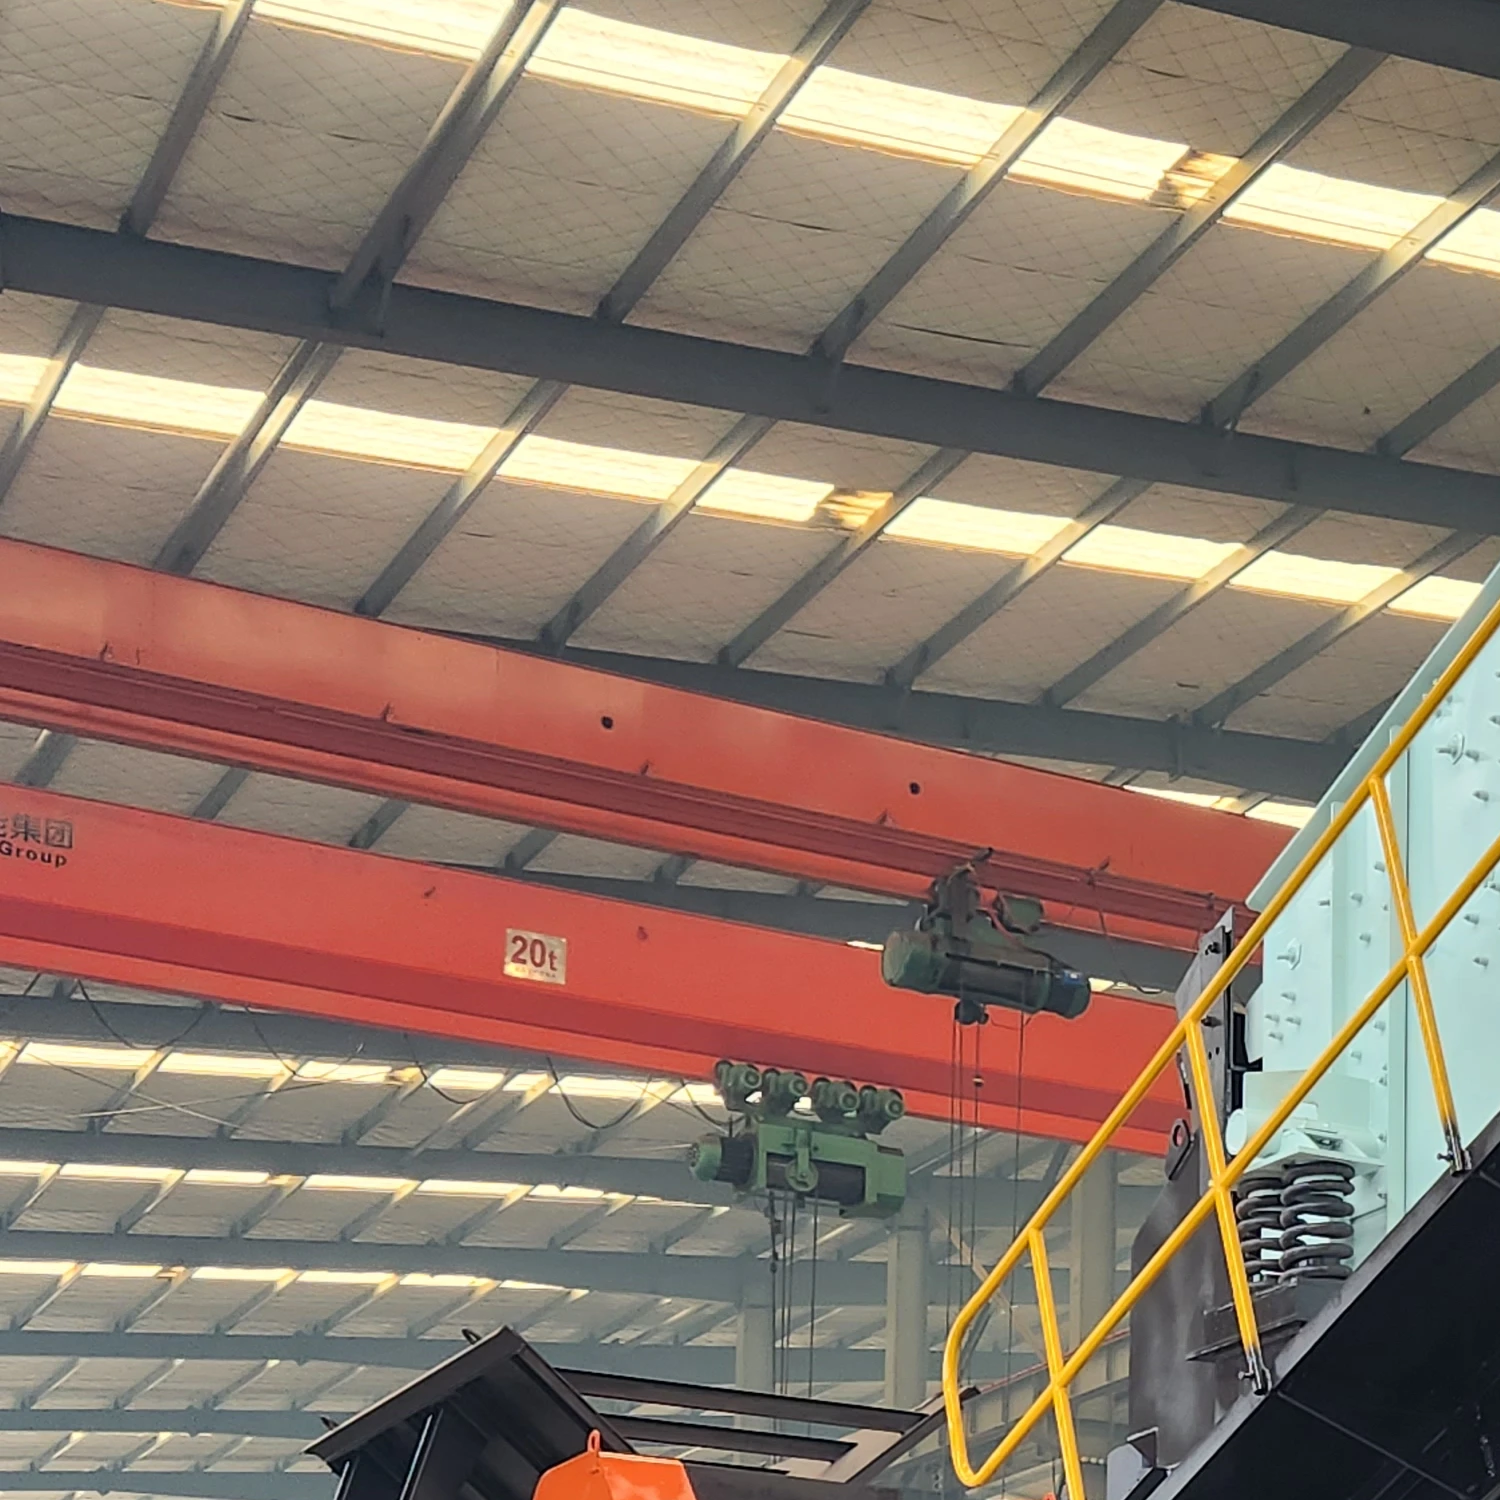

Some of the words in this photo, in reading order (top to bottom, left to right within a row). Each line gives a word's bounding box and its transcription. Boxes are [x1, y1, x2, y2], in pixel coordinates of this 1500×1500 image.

[0, 813, 73, 850] 集团
[0, 840, 68, 869] Group
[511, 934, 558, 972] 20t
